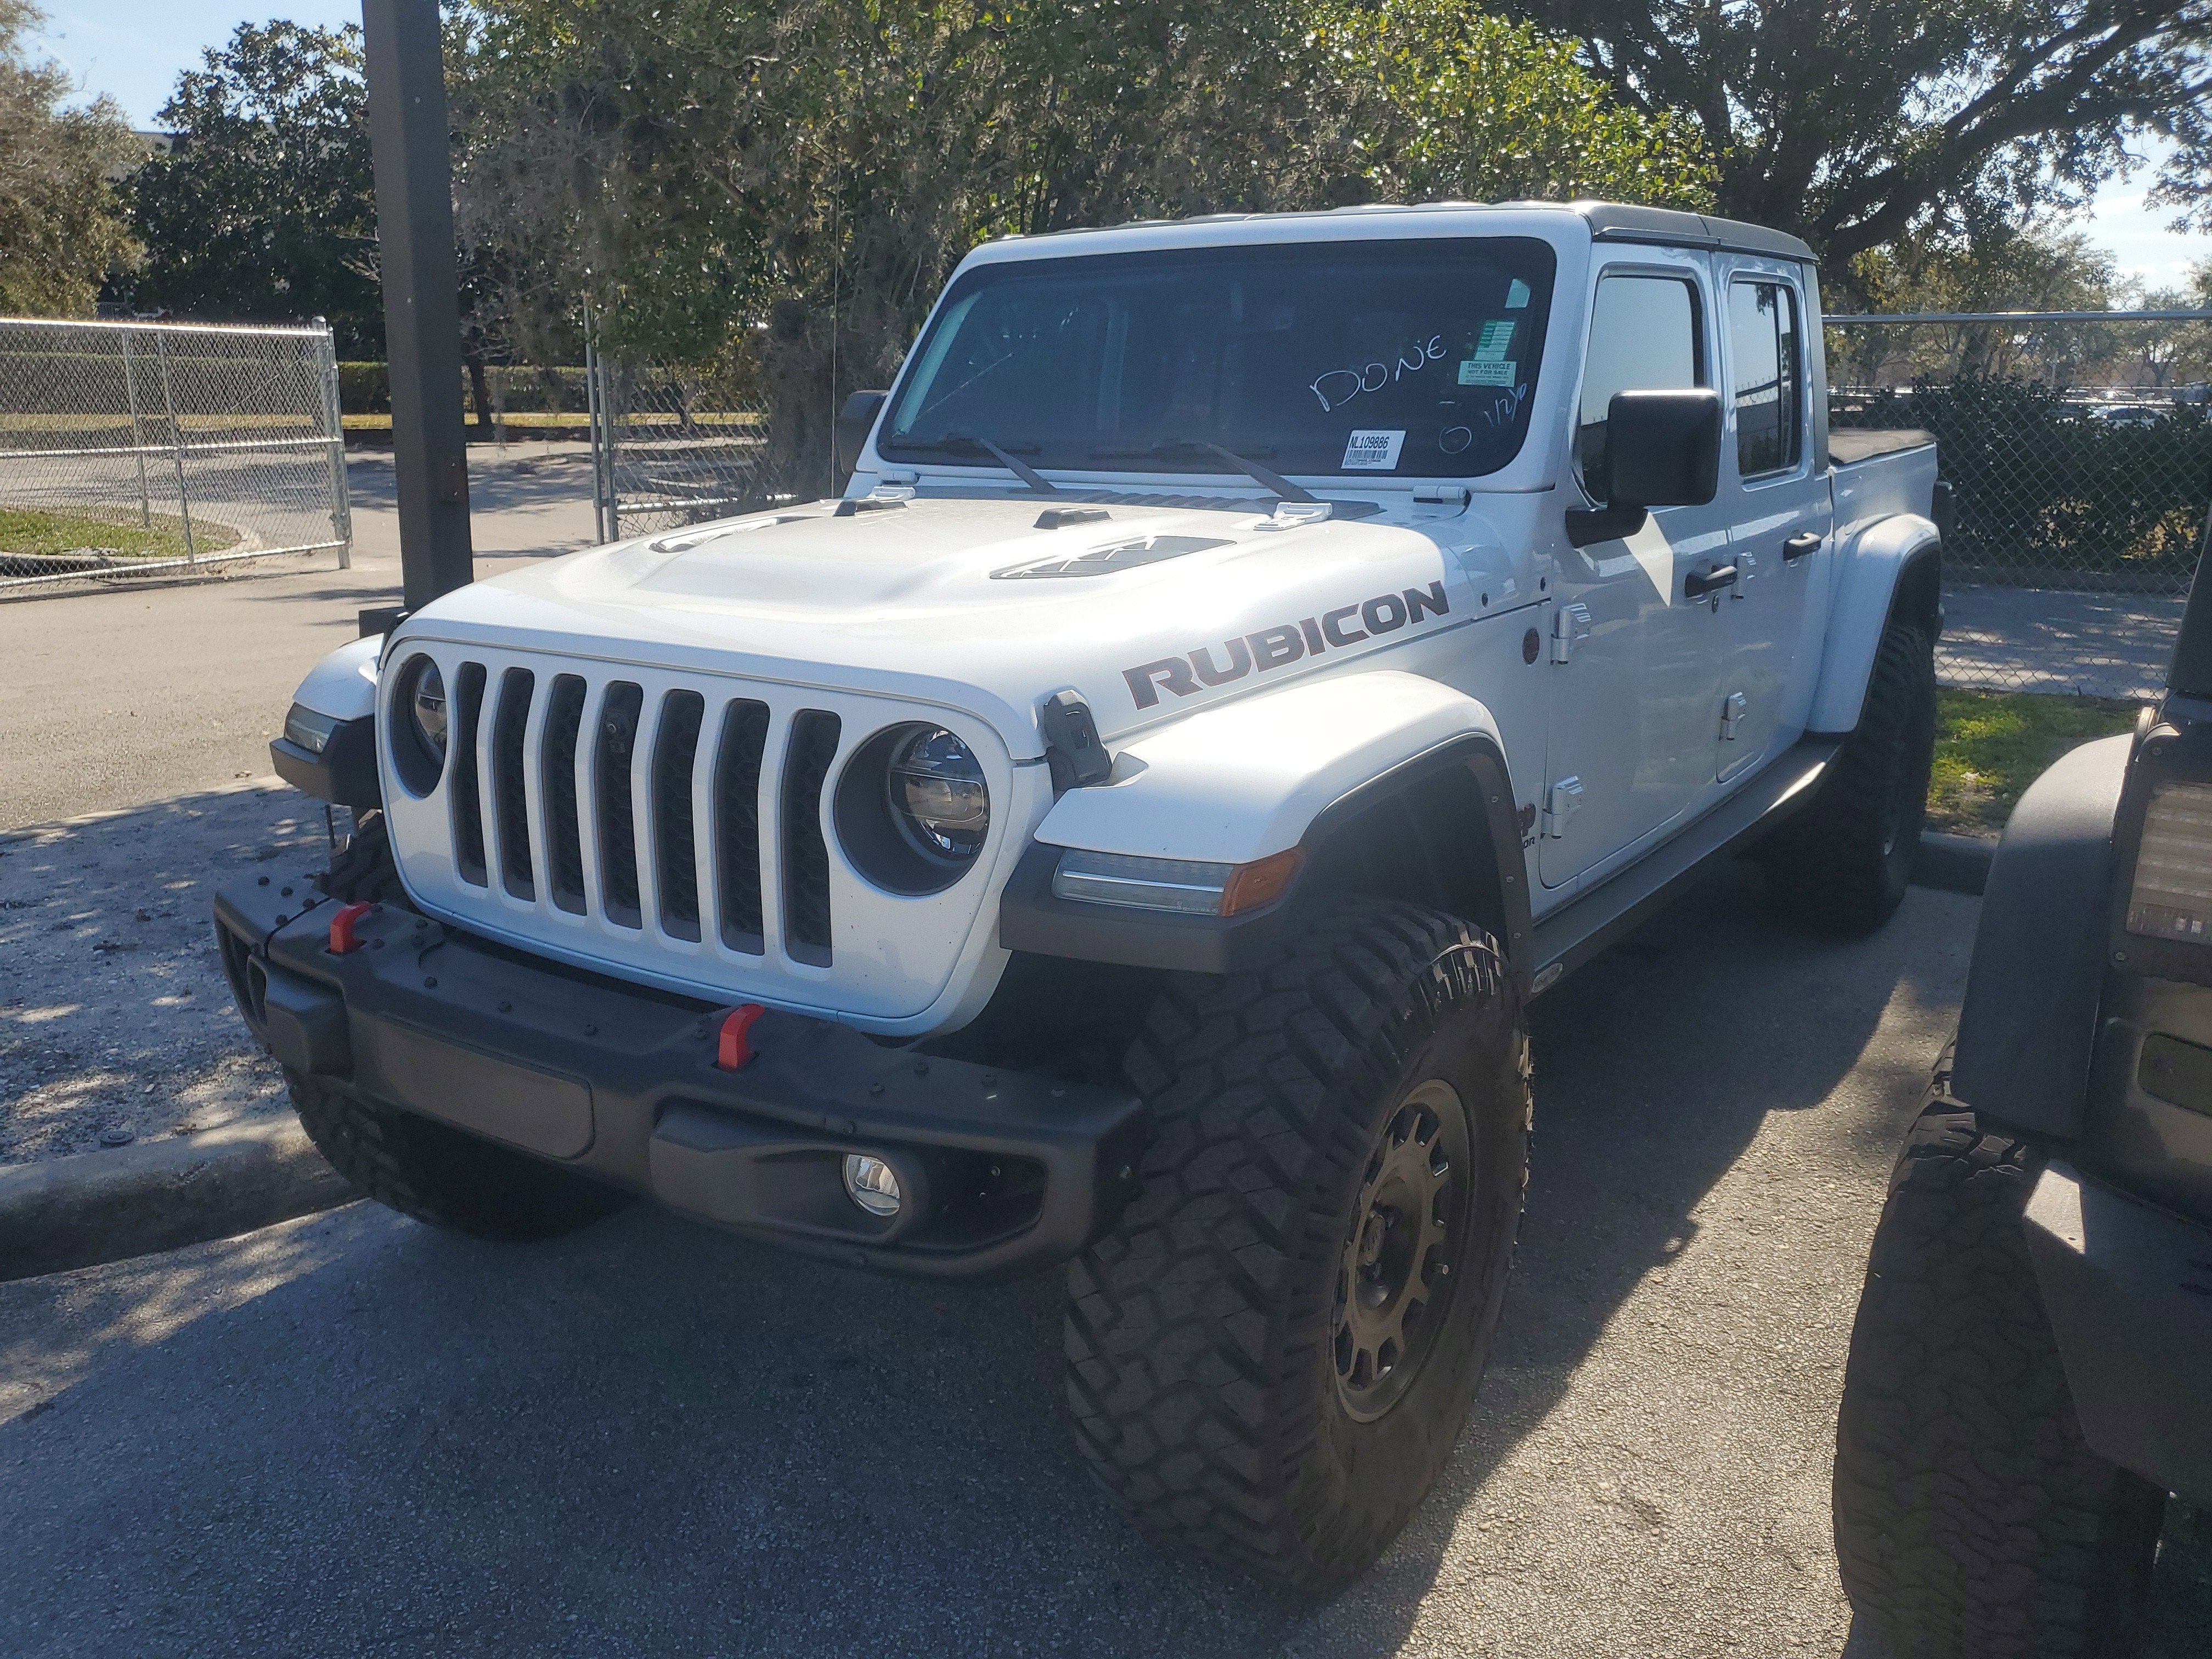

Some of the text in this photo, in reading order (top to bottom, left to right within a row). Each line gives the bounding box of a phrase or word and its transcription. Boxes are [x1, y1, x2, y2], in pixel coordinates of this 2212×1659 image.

[1310, 335, 1447, 412] DONE
[1348, 436, 1390, 449] NL109886
[1121, 580, 1450, 710] RUBICON
